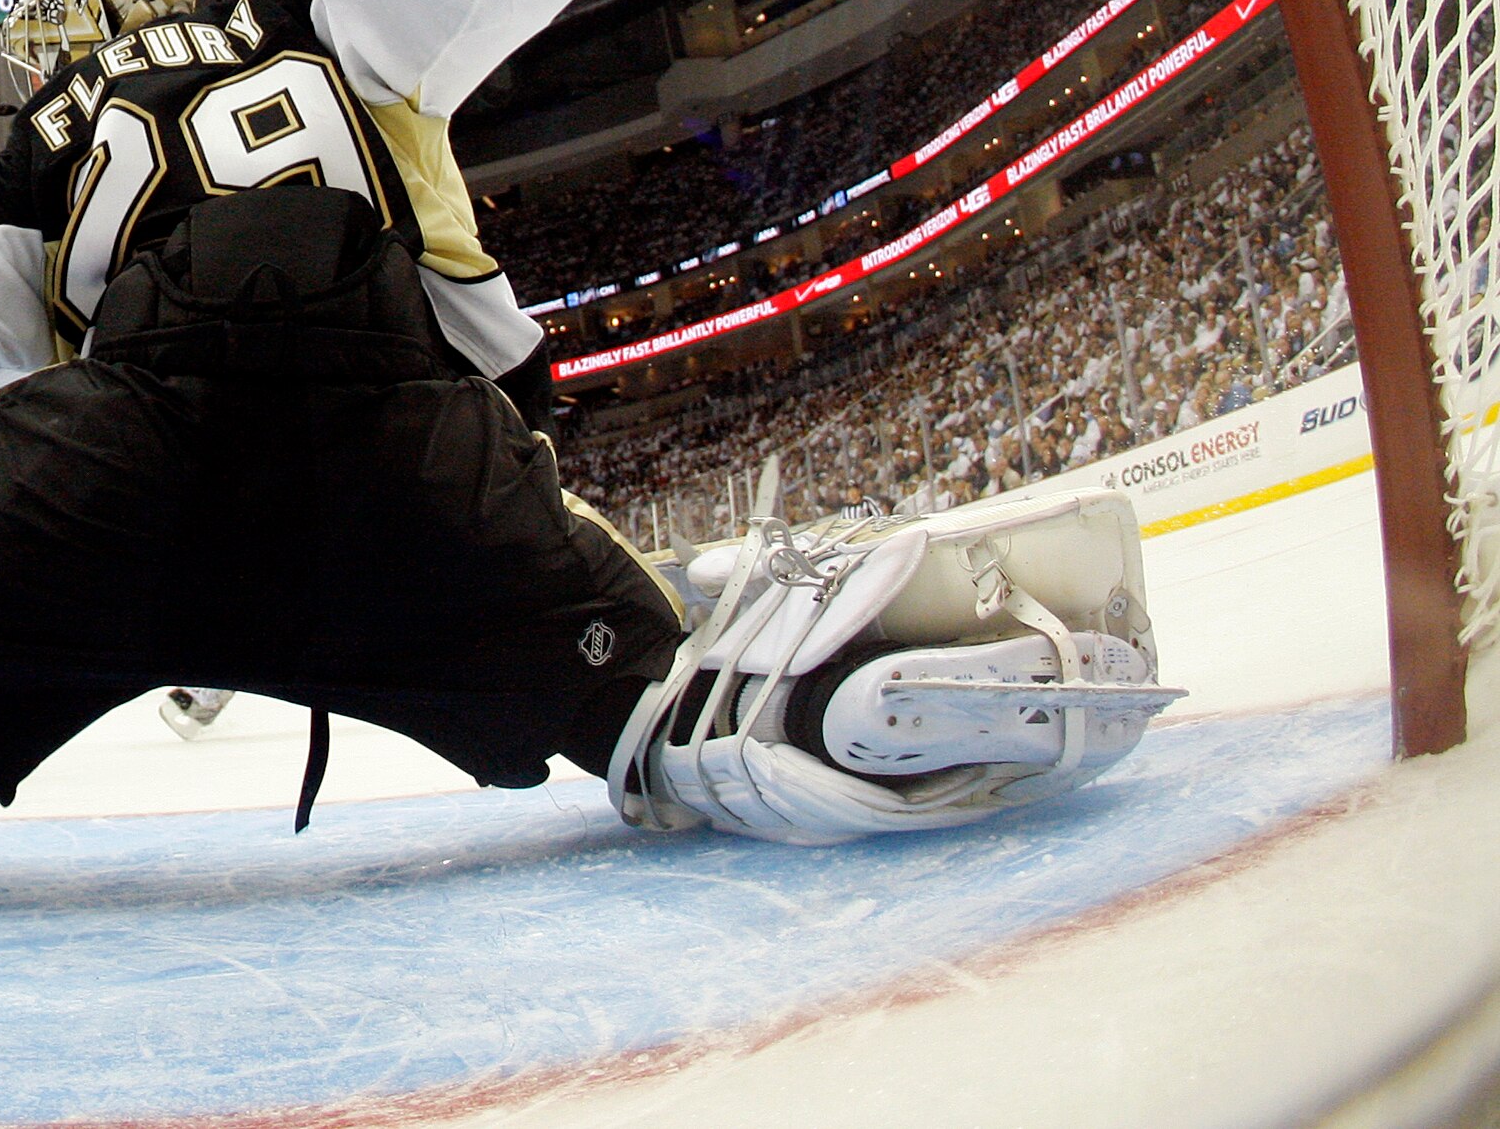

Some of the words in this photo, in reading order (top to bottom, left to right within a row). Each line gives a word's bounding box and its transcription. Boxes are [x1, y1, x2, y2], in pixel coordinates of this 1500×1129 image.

[1041, 23, 1088, 69] BLAZINGLY
[861, 226, 923, 271] INTRODUCING
[920, 208, 958, 237] VERIZON
[1006, 141, 1059, 186] BLAZINGLY
[1056, 118, 1087, 149] FAST.
[1147, 29, 1216, 87] POWERFUL.
[558, 348, 623, 377] BLAZINGLY
[622, 341, 652, 362] FAST.
[715, 299, 779, 332] POWERFUL.
[1300, 396, 1357, 435] BUD
[1121, 450, 1190, 487] CONSOL
[1190, 421, 1260, 464] ENERGY
